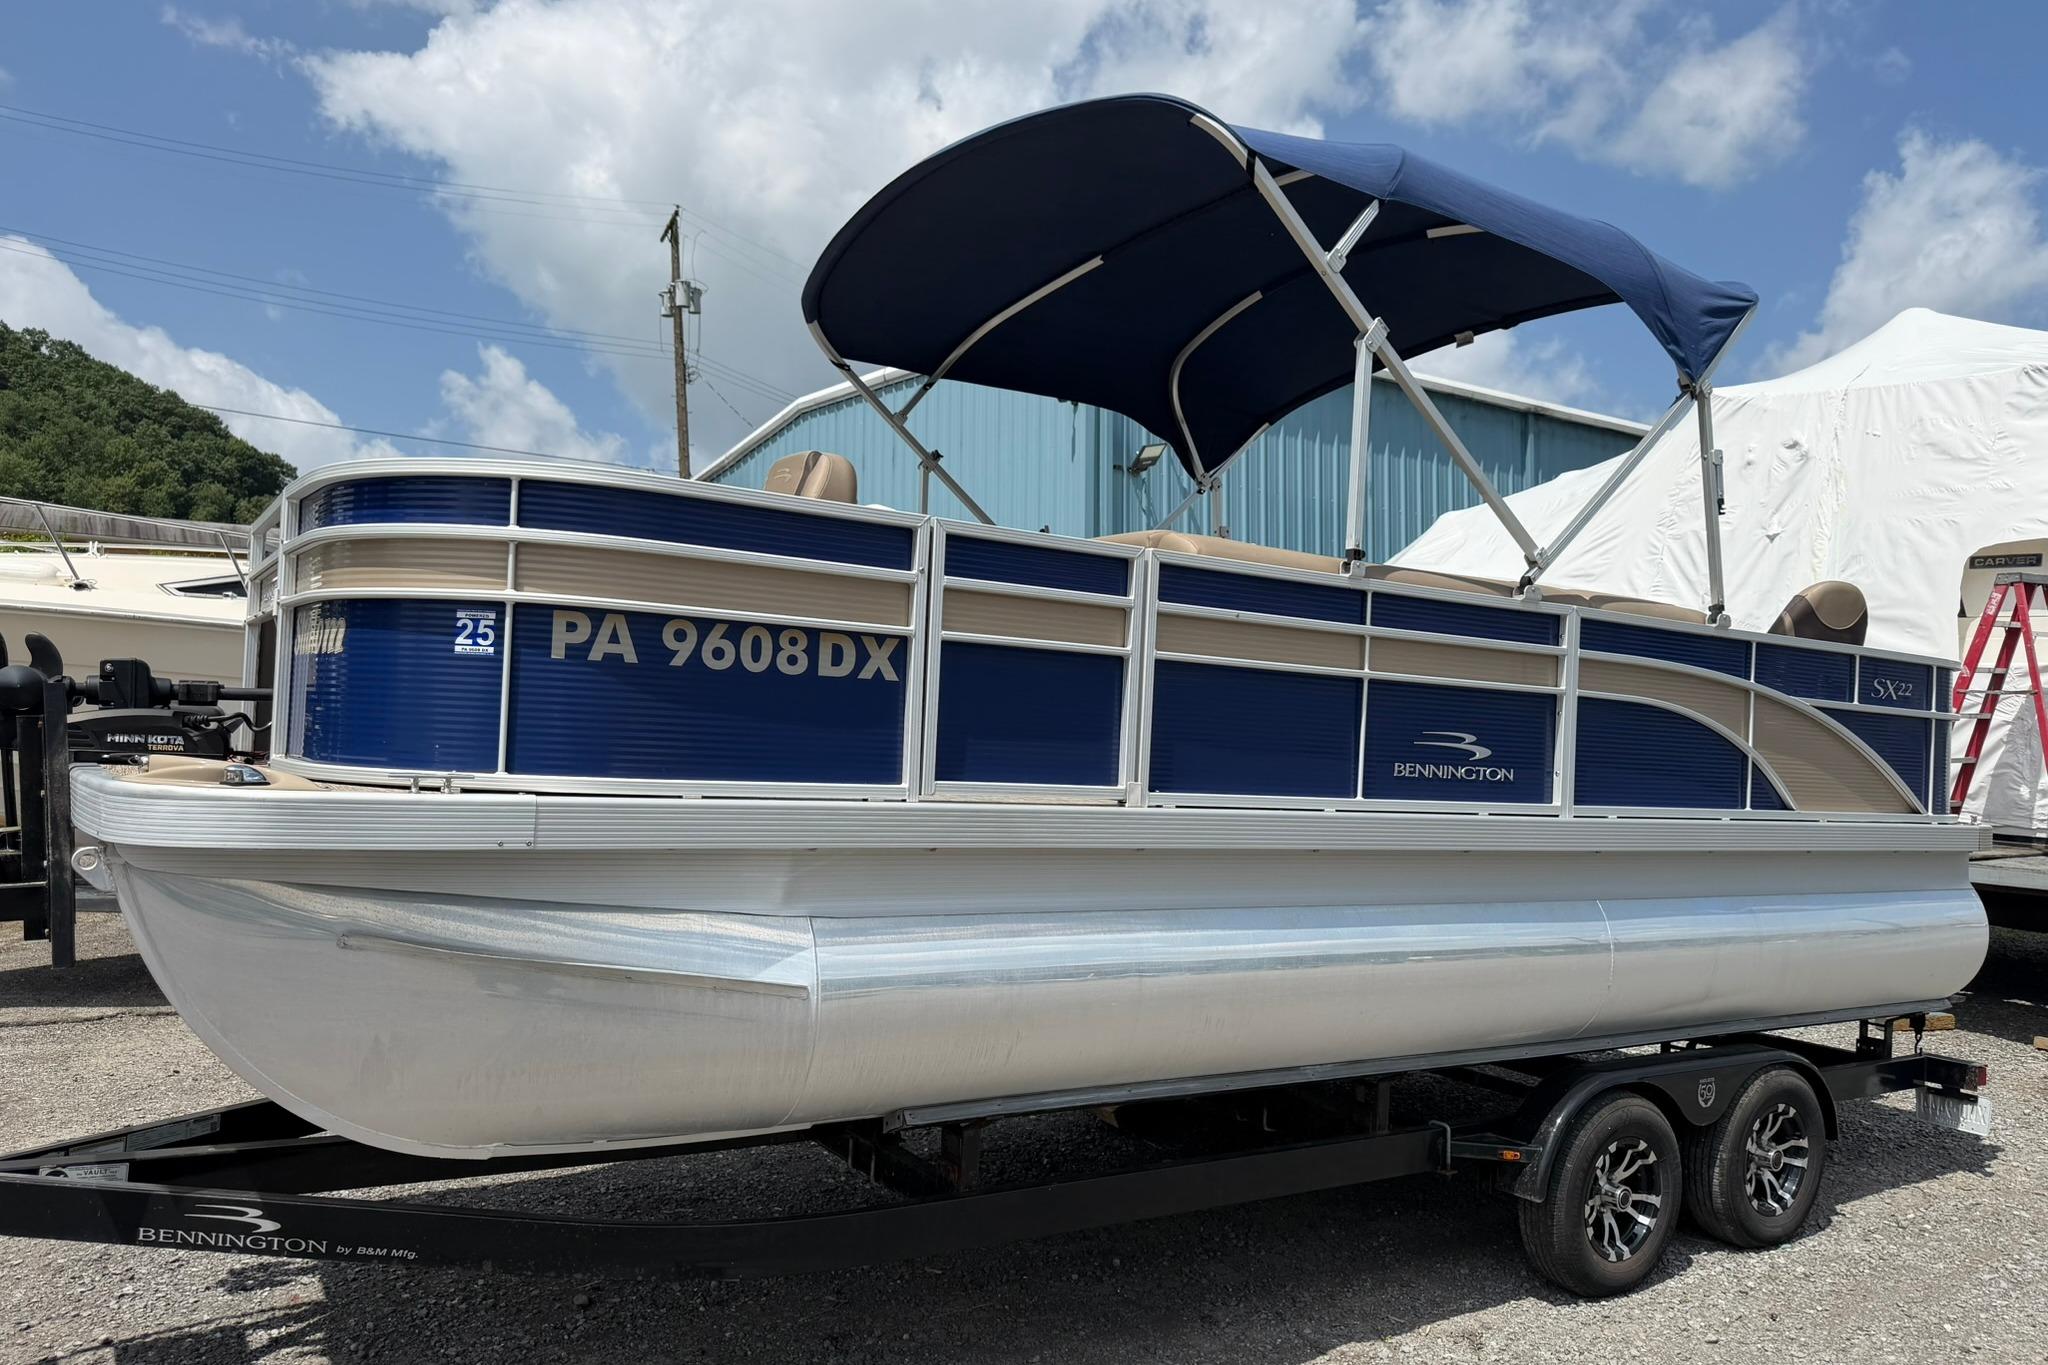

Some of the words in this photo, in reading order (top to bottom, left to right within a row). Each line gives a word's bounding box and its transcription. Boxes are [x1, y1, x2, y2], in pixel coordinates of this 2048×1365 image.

[1974, 557, 2037, 566] CARVER
[455, 618, 495, 645] 25
[551, 610, 638, 664] PA
[1871, 678, 1913, 700] SX22
[107, 733, 146, 743] MINN
[147, 734, 185, 745] KOTA
[147, 744, 184, 752] TERROVA
[1393, 762, 1515, 782] BENNINGTON
[83, 1168, 108, 1176] VAULT
[137, 1227, 328, 1254] BENNINGTON
[335, 1245, 352, 1255] by
[356, 1246, 388, 1257] B&M
[390, 1248, 419, 1260] Mfg.
